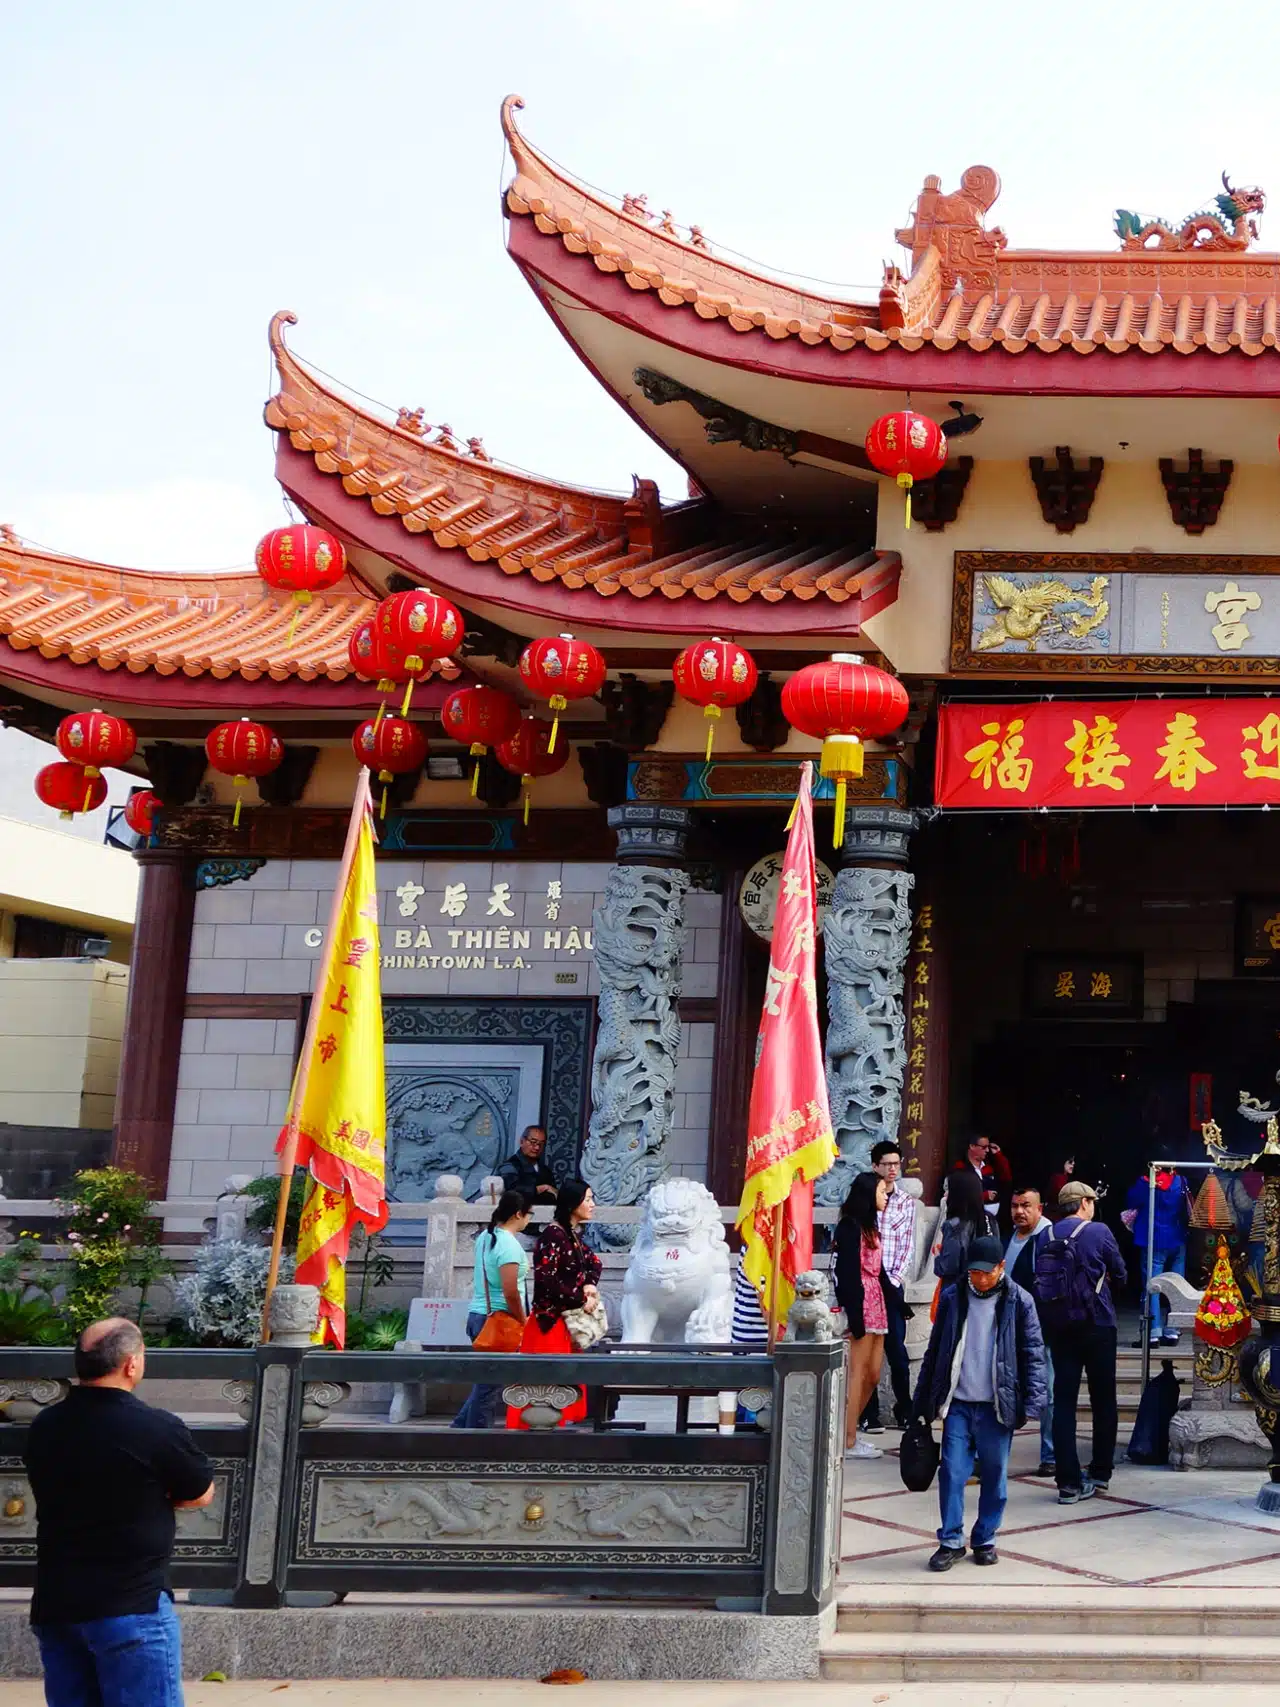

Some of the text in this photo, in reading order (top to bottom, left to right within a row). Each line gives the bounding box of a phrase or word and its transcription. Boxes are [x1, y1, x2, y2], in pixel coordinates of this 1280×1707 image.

[396, 881, 514, 917] 天后宮
[396, 924, 432, 949] BÀ
[448, 925, 530, 950] THIÊN
[379, 956, 532, 969] HINATOWN L.A.
[665, 1249, 680, 1260] 福
